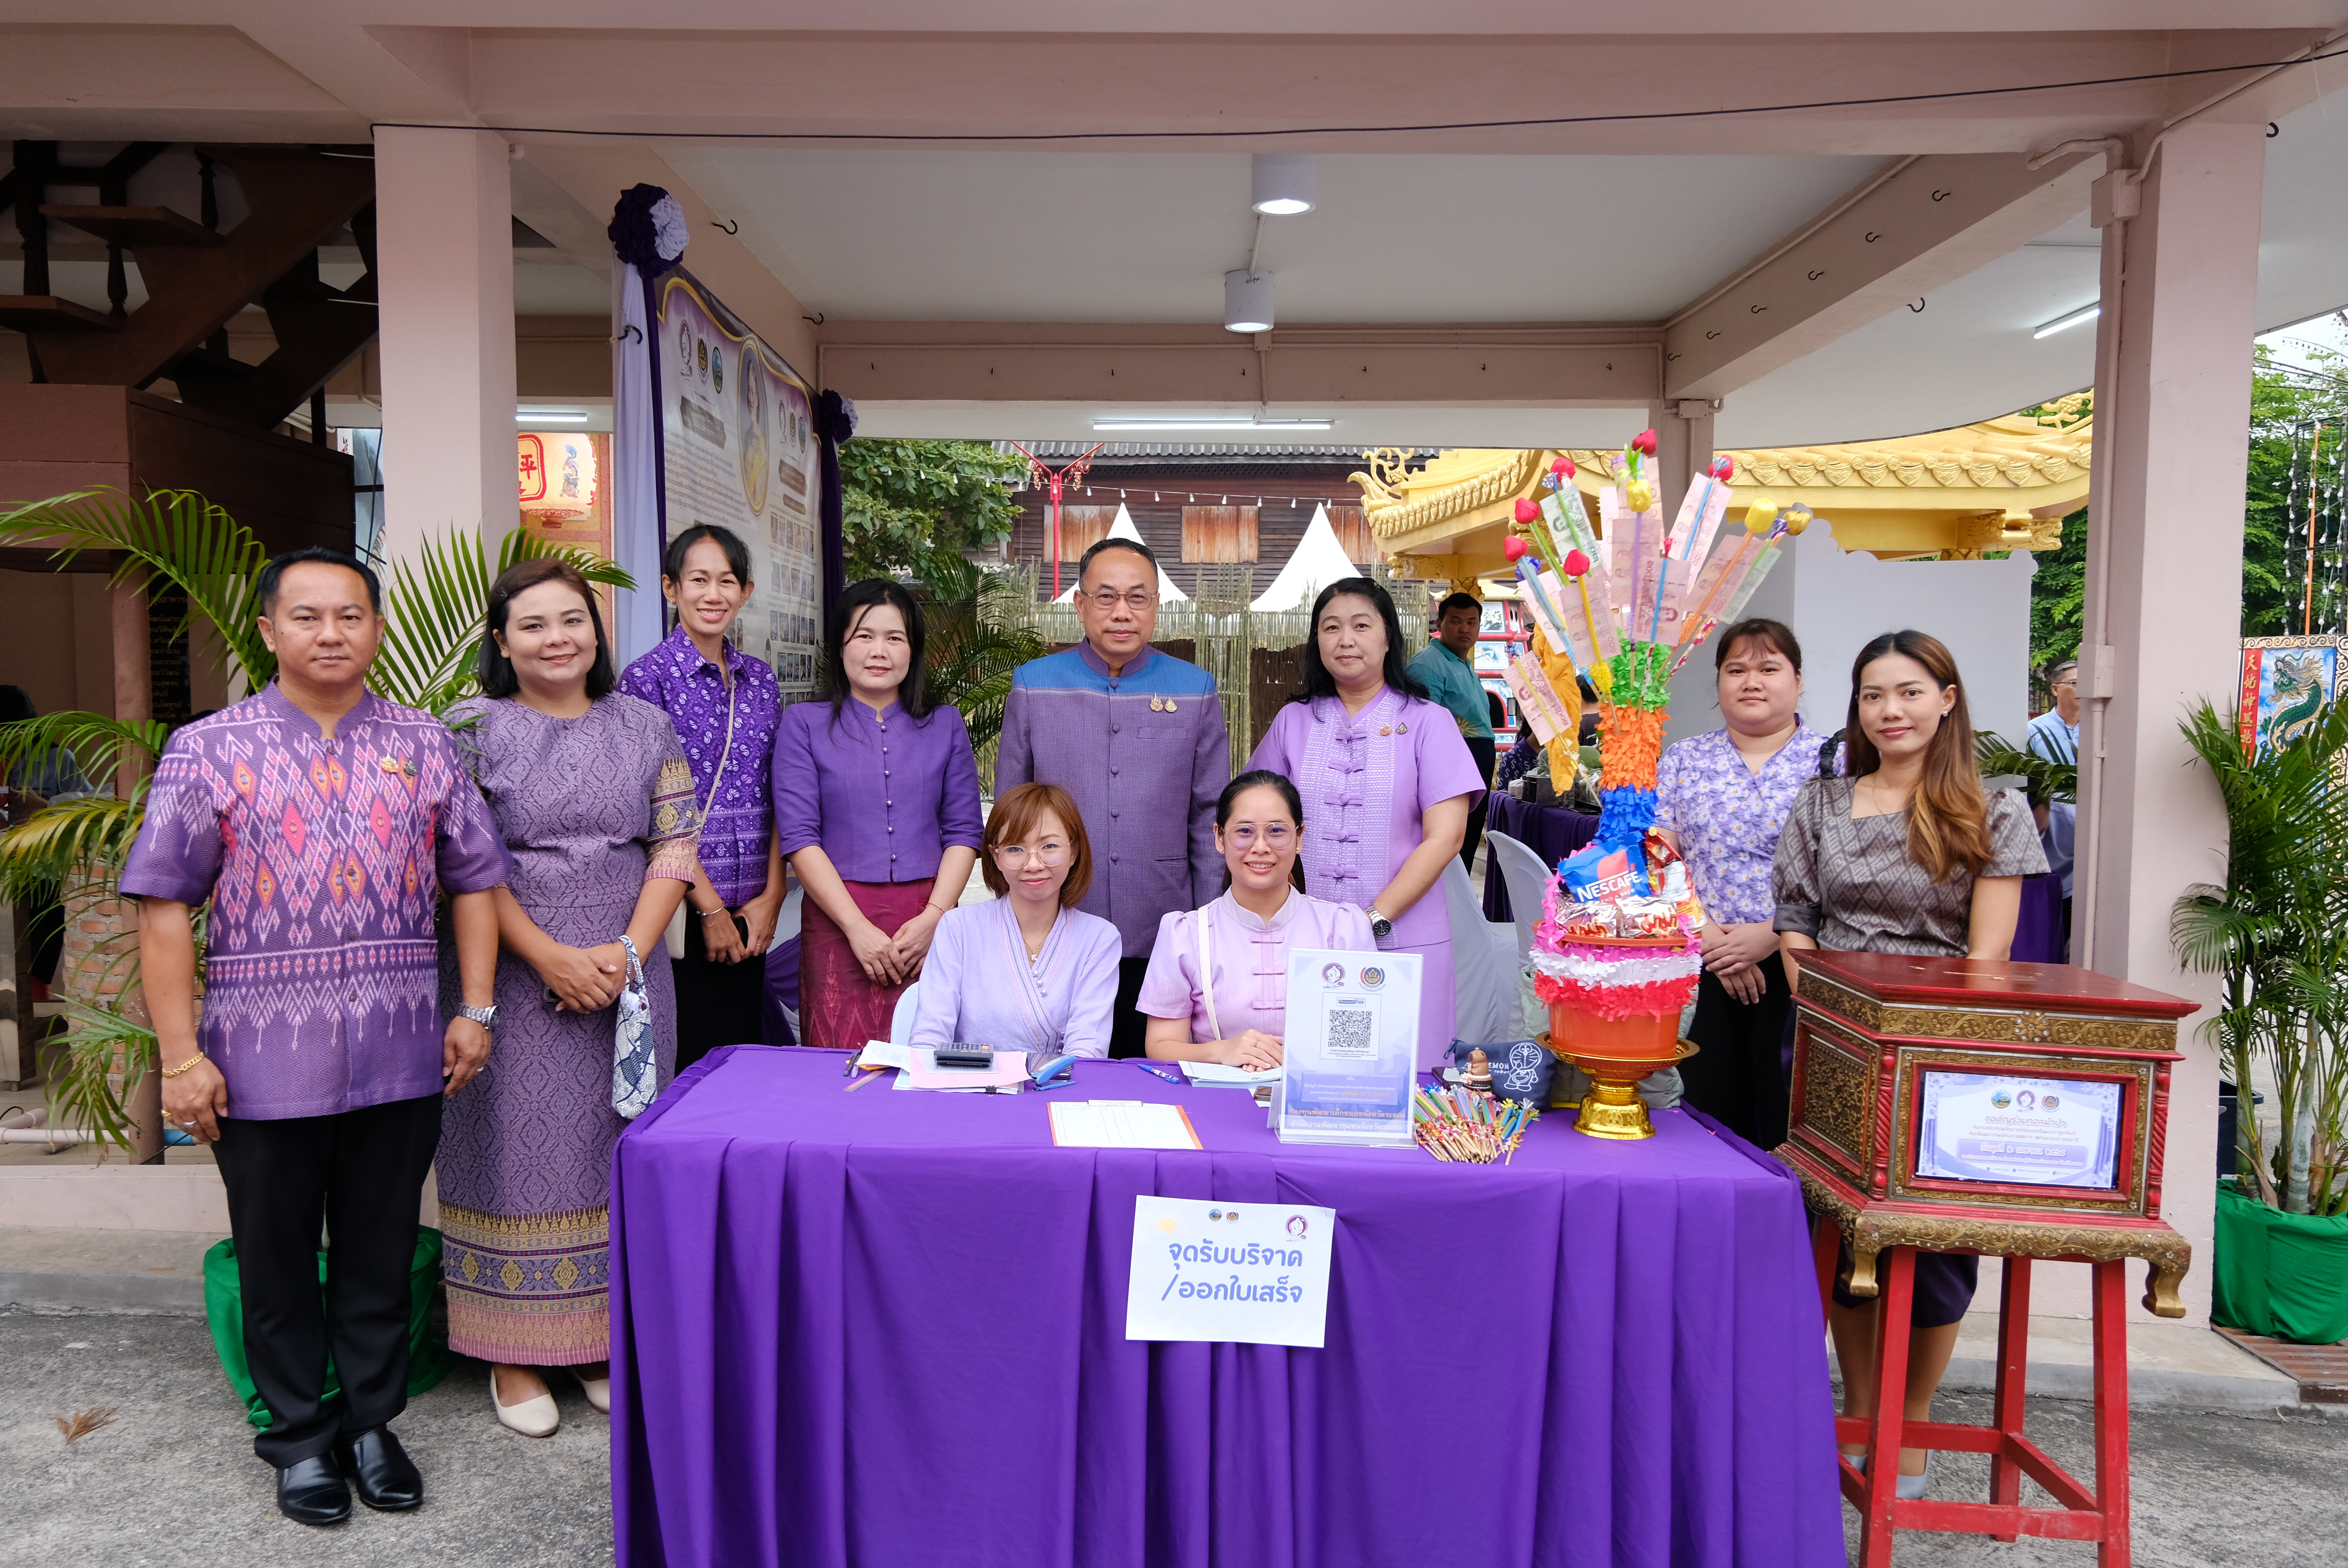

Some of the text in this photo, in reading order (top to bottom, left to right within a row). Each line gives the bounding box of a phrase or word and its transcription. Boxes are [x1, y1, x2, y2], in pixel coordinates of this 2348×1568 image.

[1620, 888, 1635, 898] BREW
[1289, 1107, 1405, 1119] กองทุนพัฒนาเด็กชนบทจังหวัดระยอง
[1290, 1120, 1402, 1131] สำนักงานพัฒนาชุมชนจังหวัดระยอง
[1985, 1115, 2066, 1127] ขอเชิญร่วมทอดผ้าป่า
[2016, 1147, 2043, 1155] เมษายน
[1169, 1239, 1302, 1270] จุดรับบริจาค
[1161, 1274, 1302, 1303] /ออกใบเสร็จ
